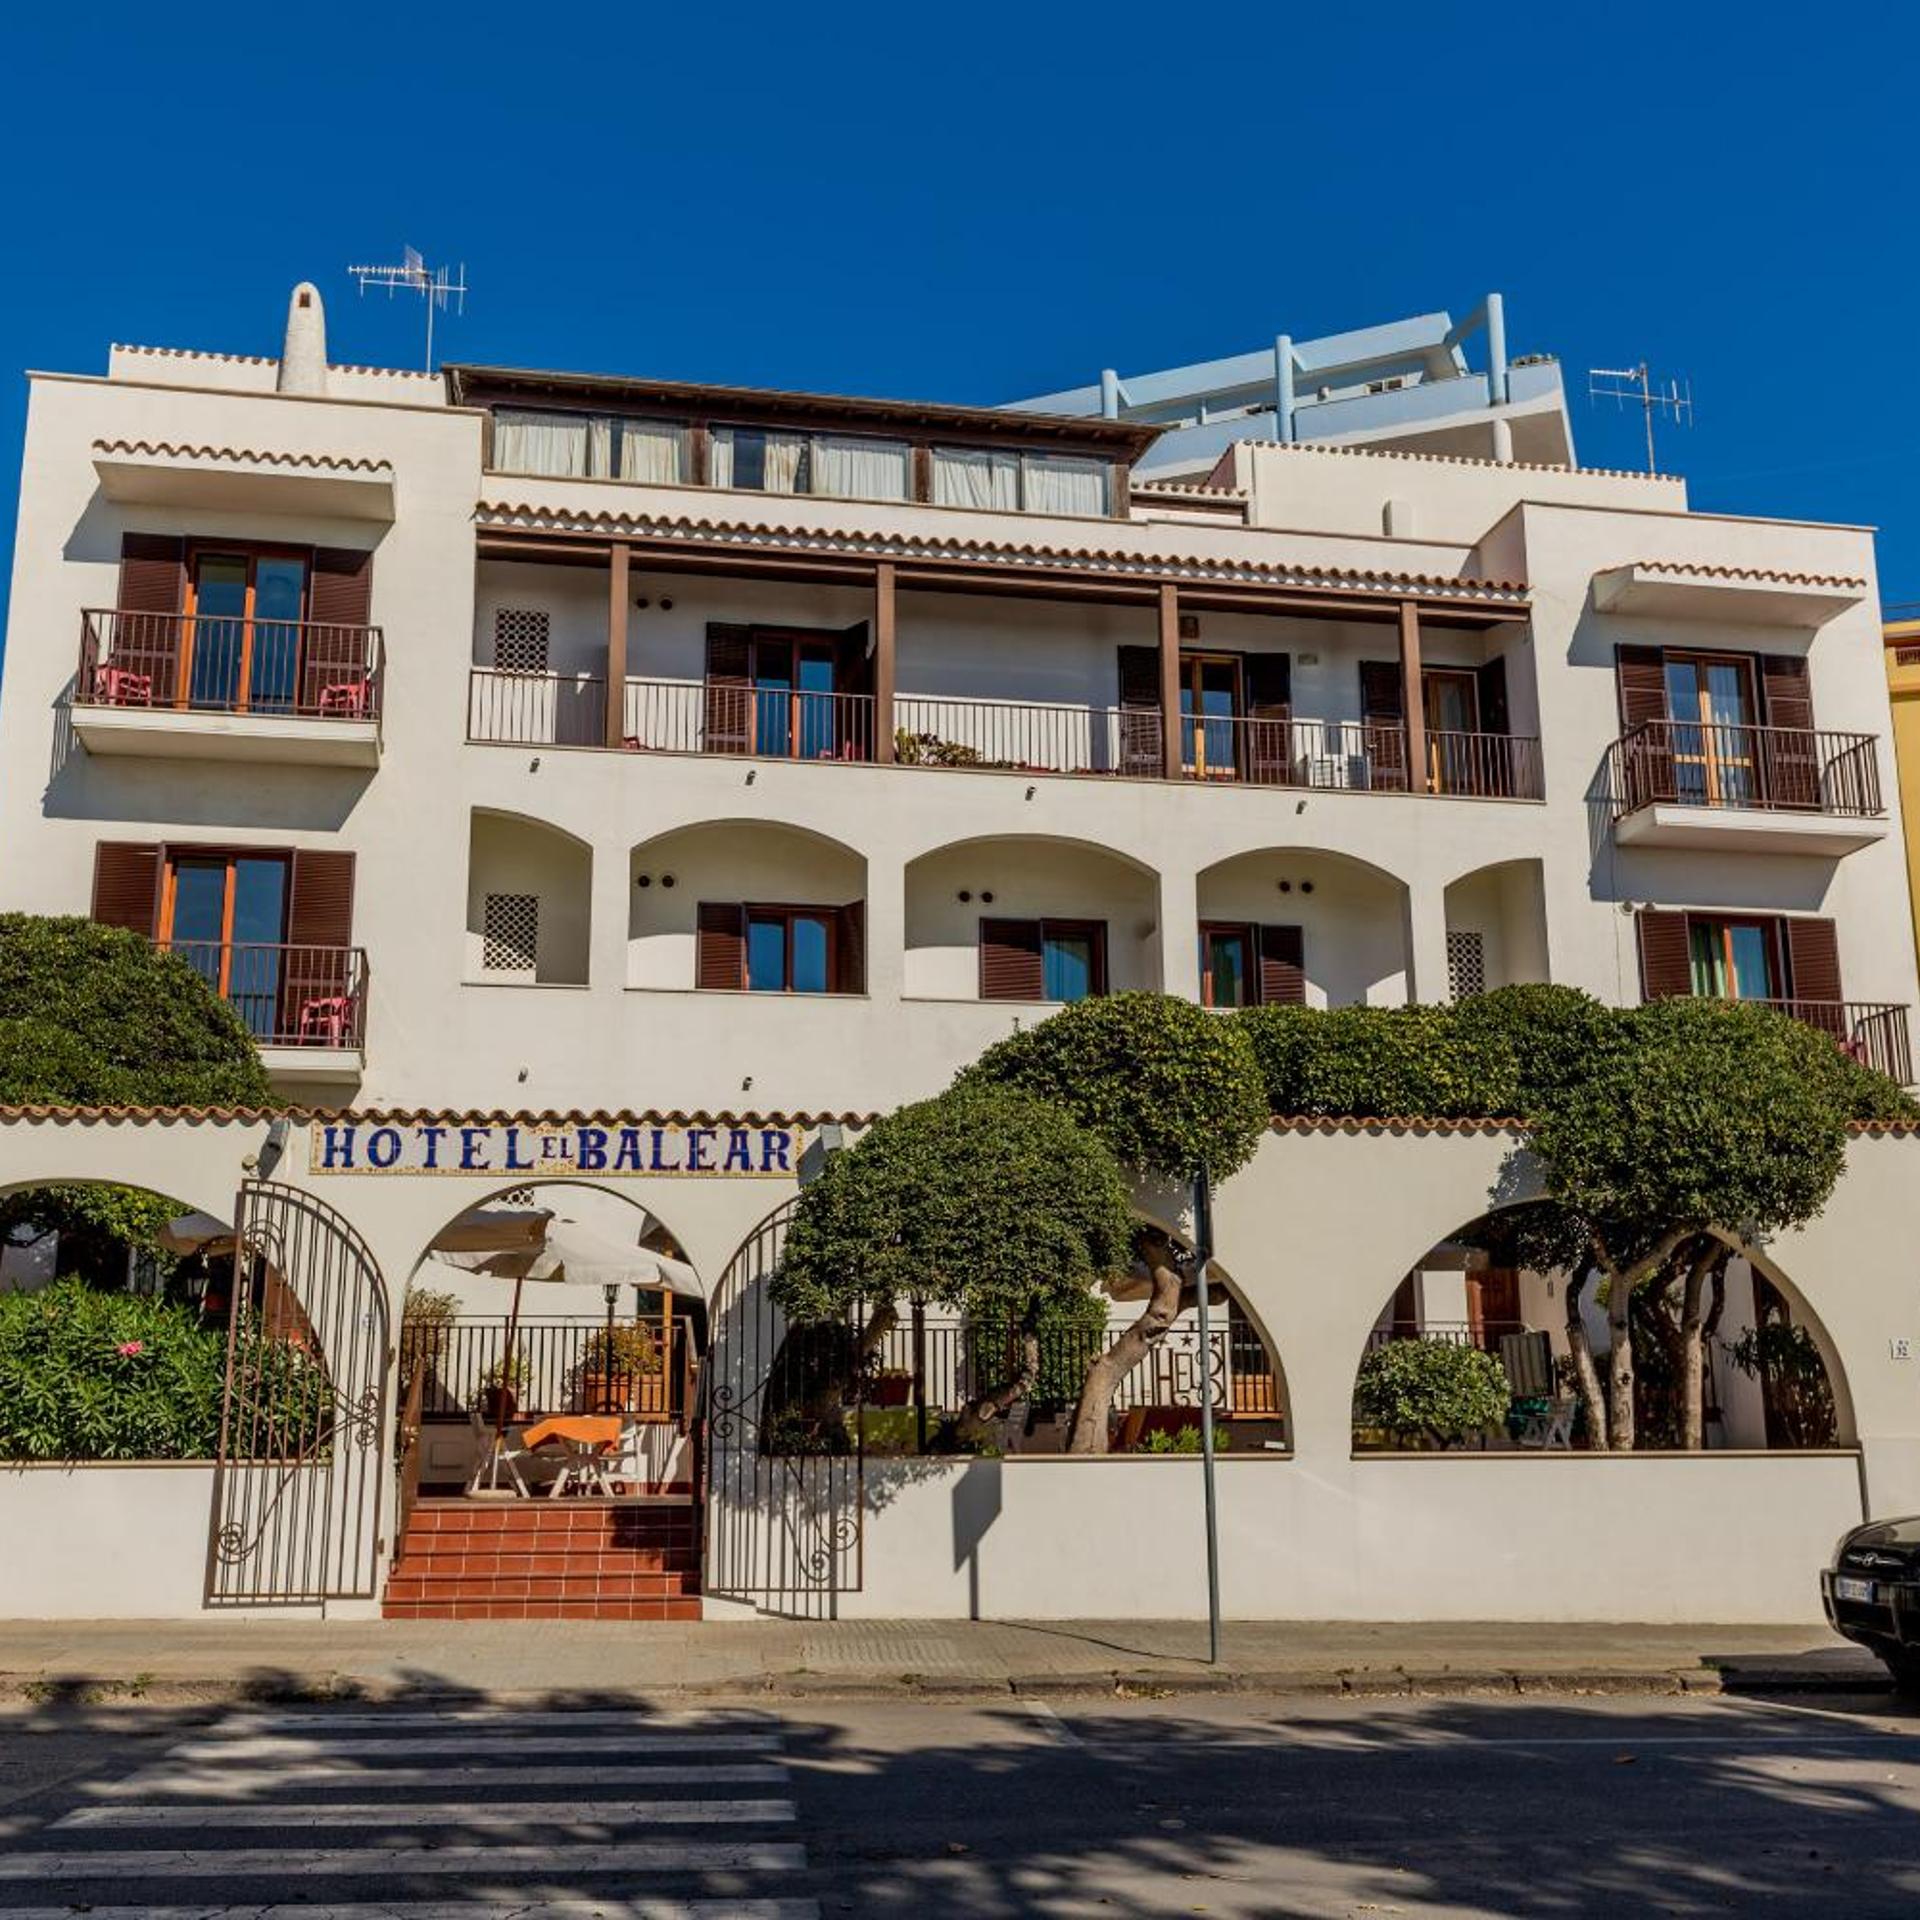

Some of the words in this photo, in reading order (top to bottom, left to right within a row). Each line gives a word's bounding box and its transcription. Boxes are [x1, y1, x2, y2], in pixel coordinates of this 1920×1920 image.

[321, 1127, 534, 1169] HOTEL
[541, 1136, 574, 1159] EL
[576, 1128, 791, 1171] BALEAR
